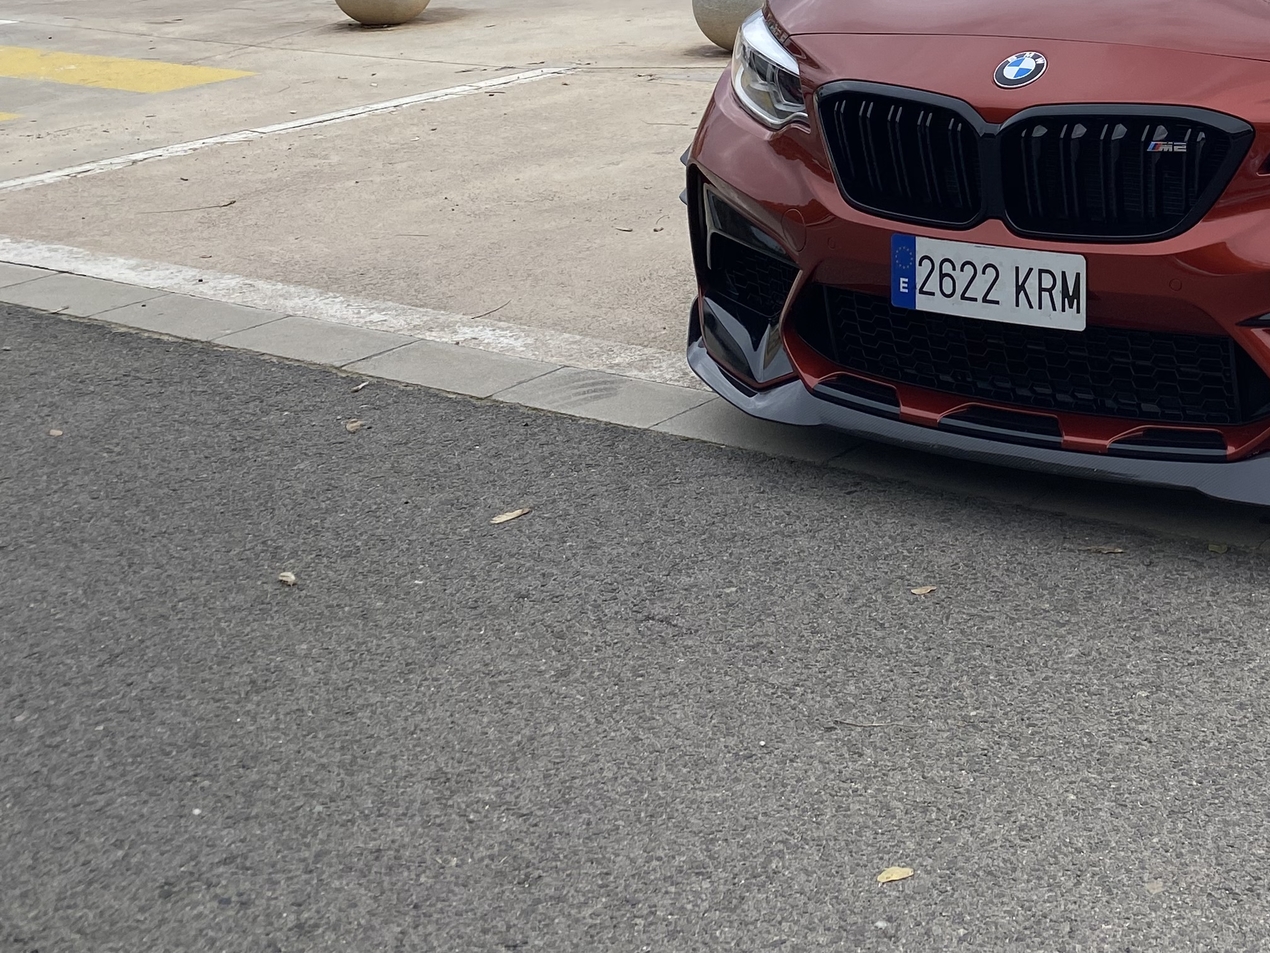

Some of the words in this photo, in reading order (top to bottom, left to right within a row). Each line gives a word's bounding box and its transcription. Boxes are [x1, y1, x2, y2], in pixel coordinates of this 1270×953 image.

[899, 277, 909, 293] E
[918, 254, 1001, 306] 2622
[1014, 265, 1081, 315] KRM
